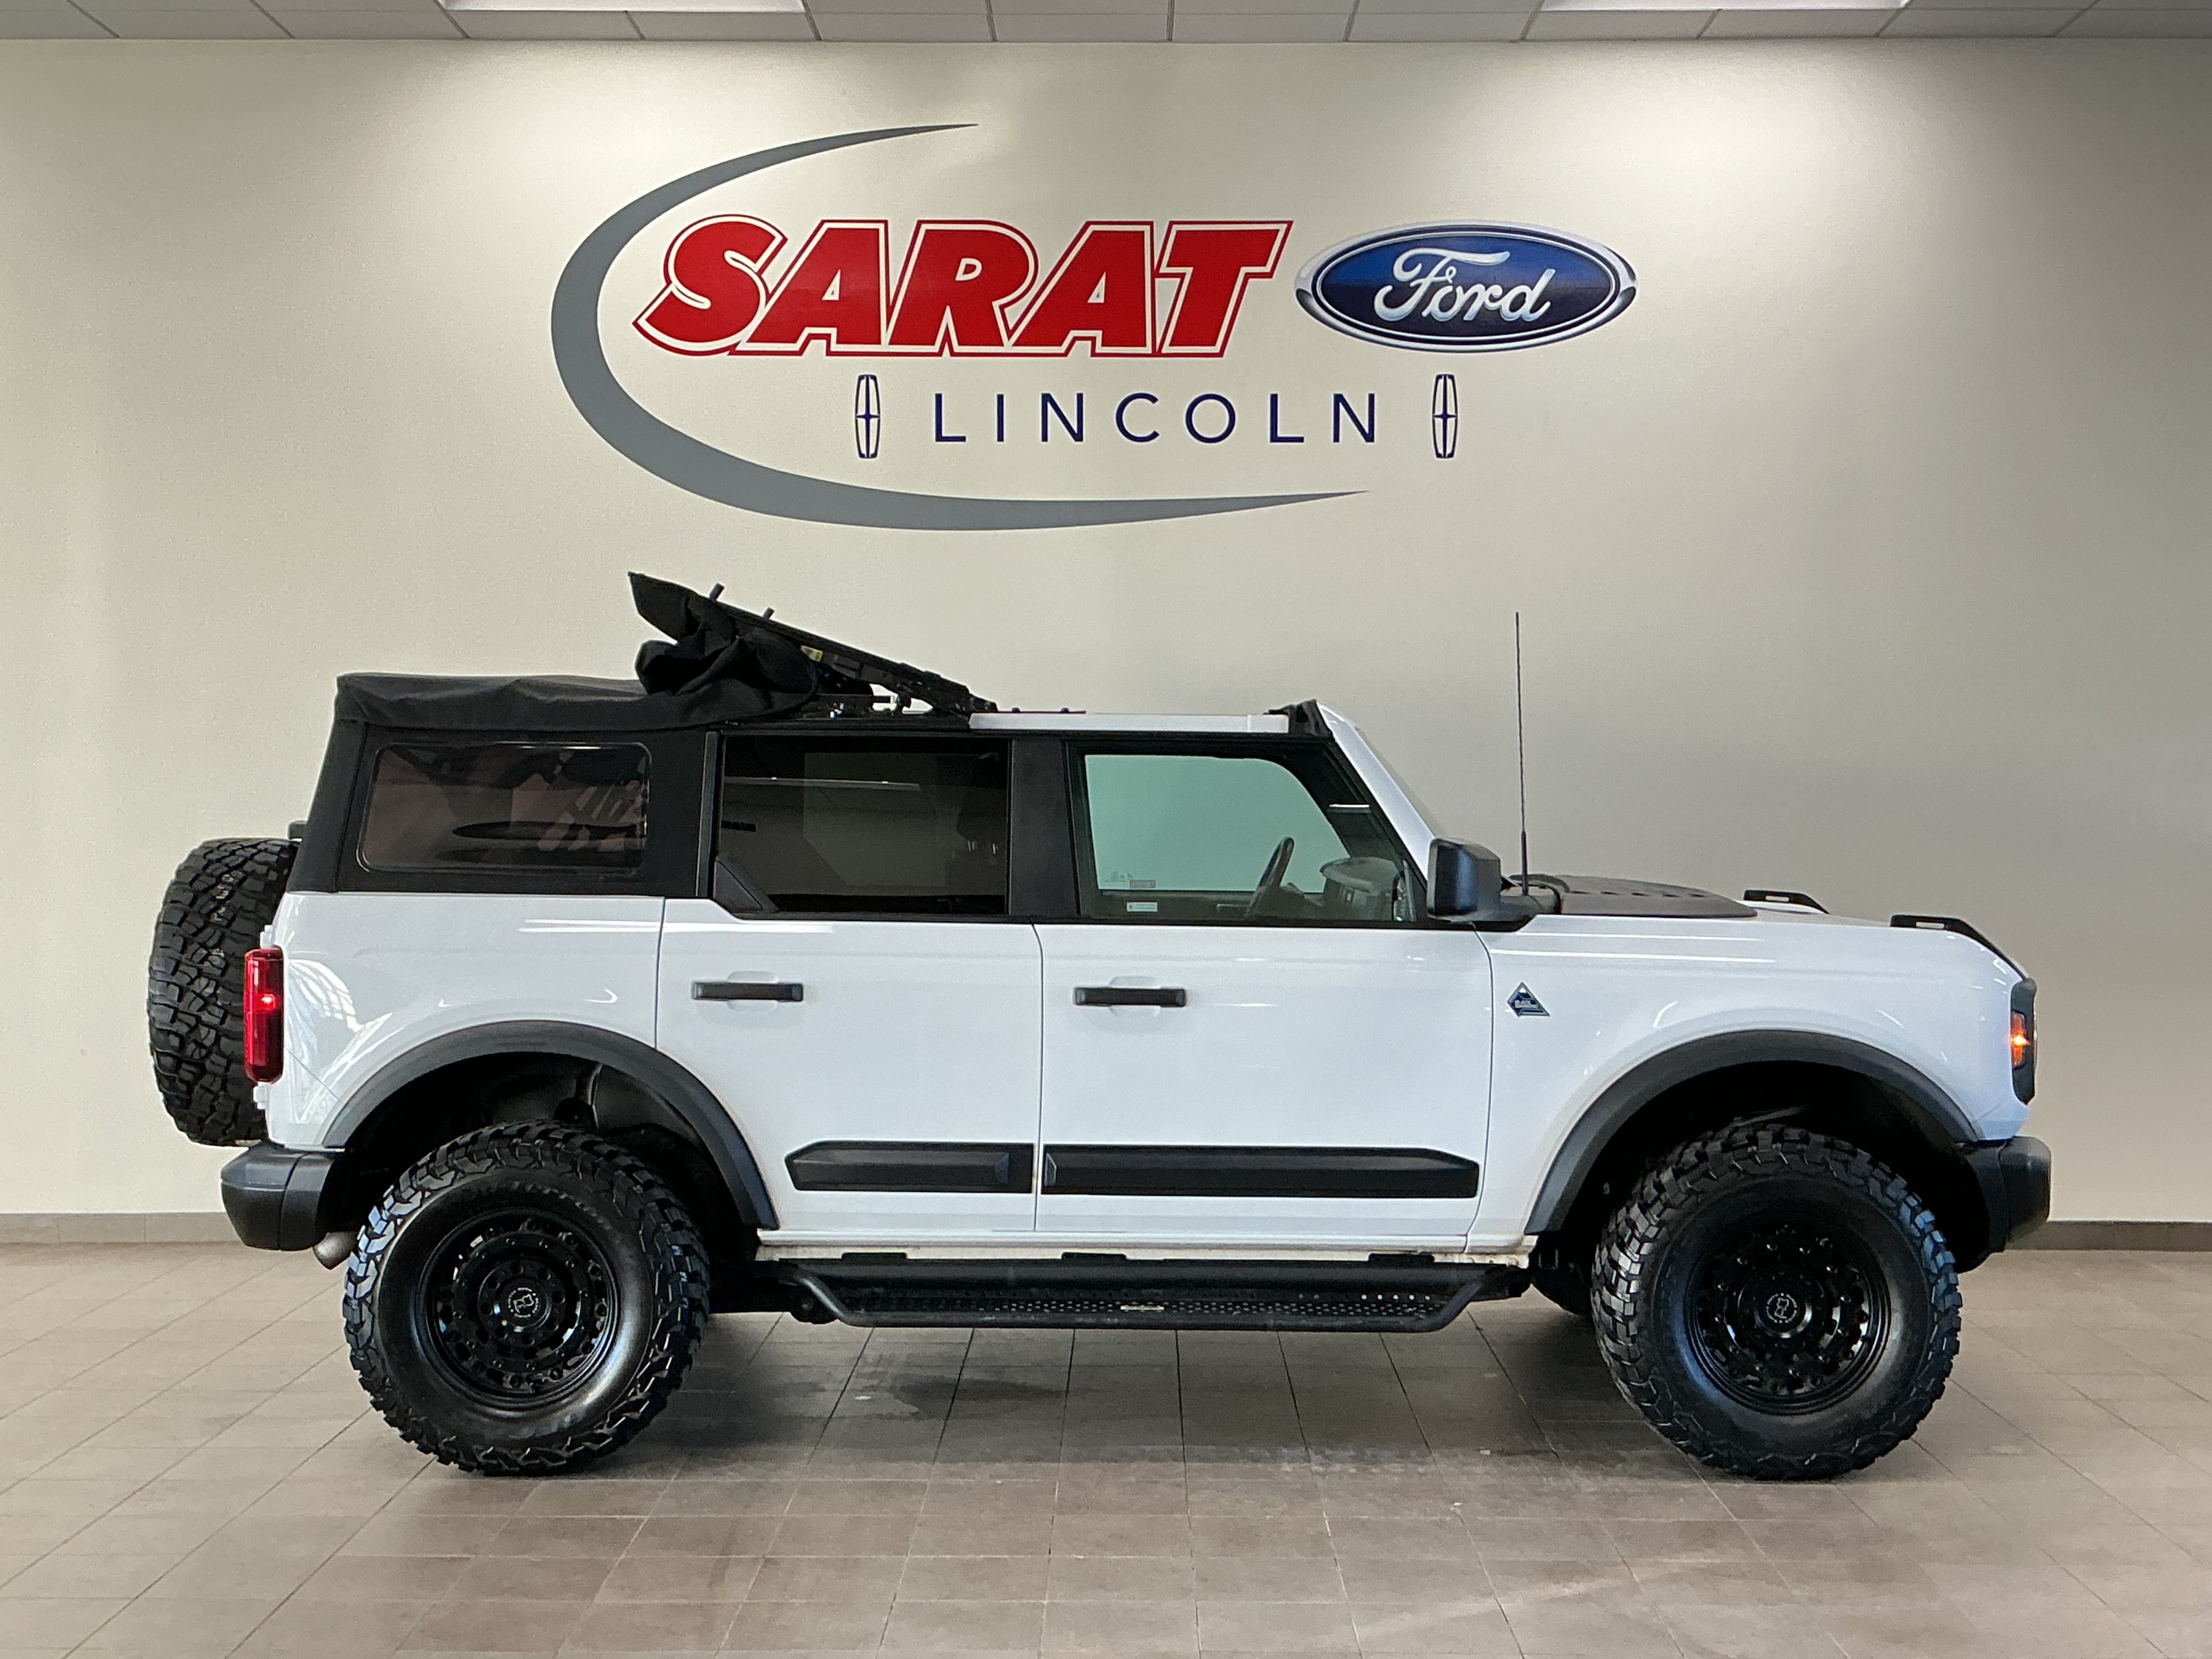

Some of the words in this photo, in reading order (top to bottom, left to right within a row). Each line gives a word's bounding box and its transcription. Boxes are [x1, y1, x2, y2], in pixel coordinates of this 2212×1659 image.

[633, 215, 1293, 358] SARAT
[1373, 247, 1555, 323] Ford
[935, 393, 1375, 443] LINCOLN
